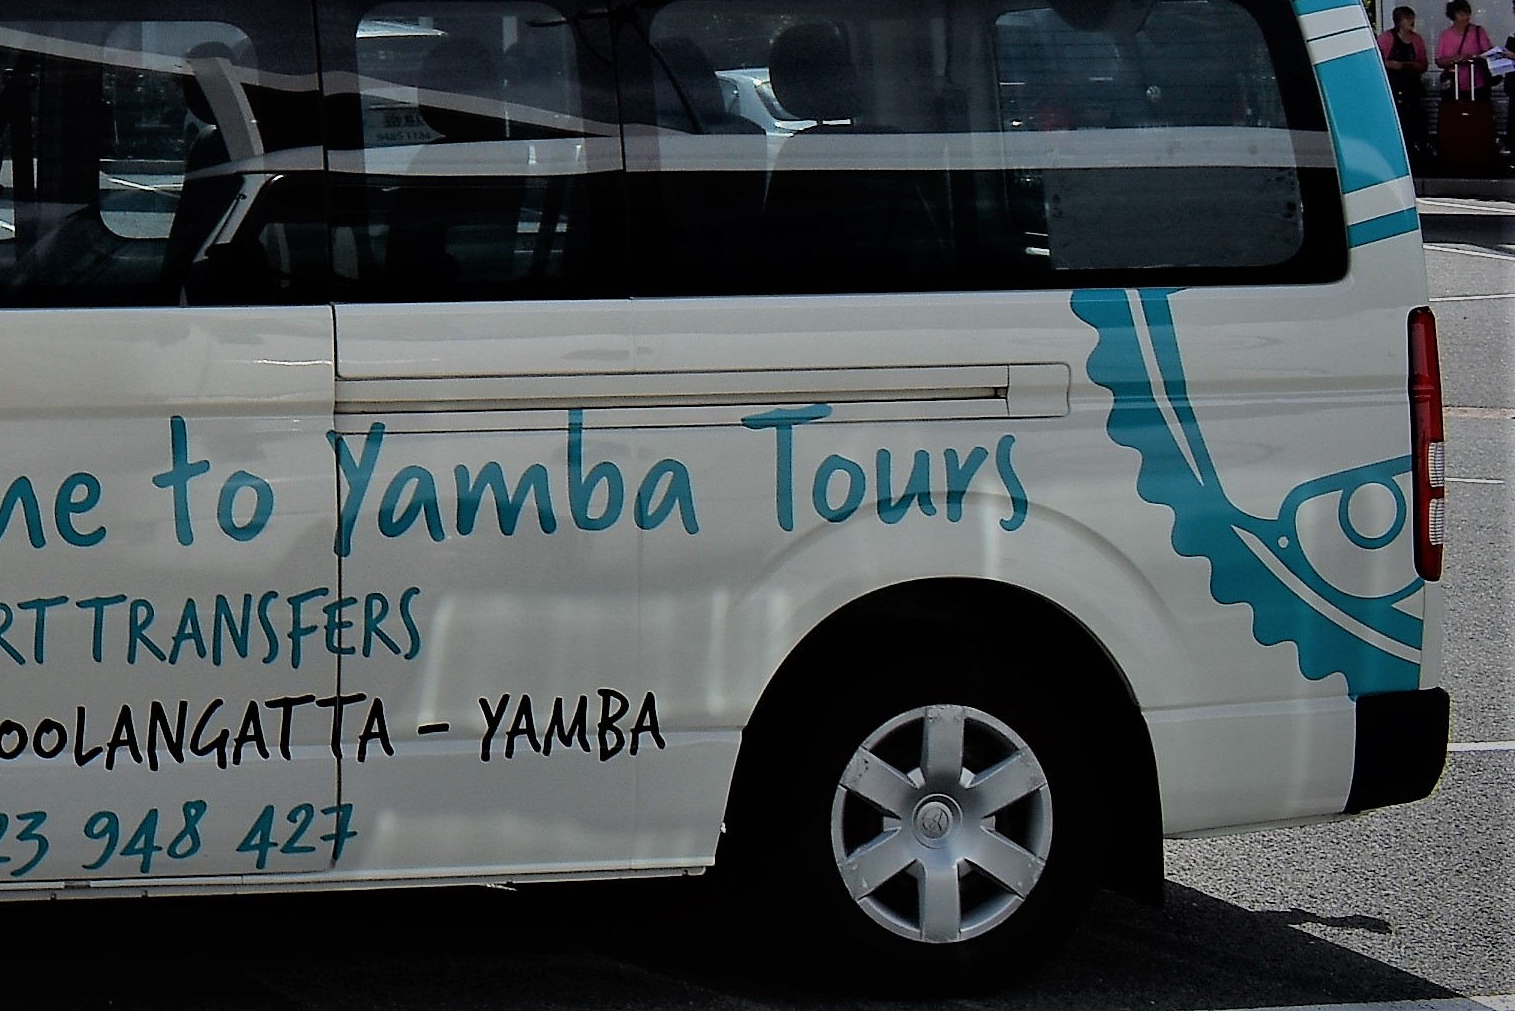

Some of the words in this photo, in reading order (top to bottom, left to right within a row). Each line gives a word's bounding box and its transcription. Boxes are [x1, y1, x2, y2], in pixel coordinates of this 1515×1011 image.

[152, 415, 276, 546] to
[326, 407, 700, 558] Yamba
[740, 402, 1030, 533] Tours
[75, 587, 422, 671] TRANSFERS
[478, 688, 666, 763] YAMBA
[84, 799, 208, 874] 948
[236, 803, 359, 871] 427
